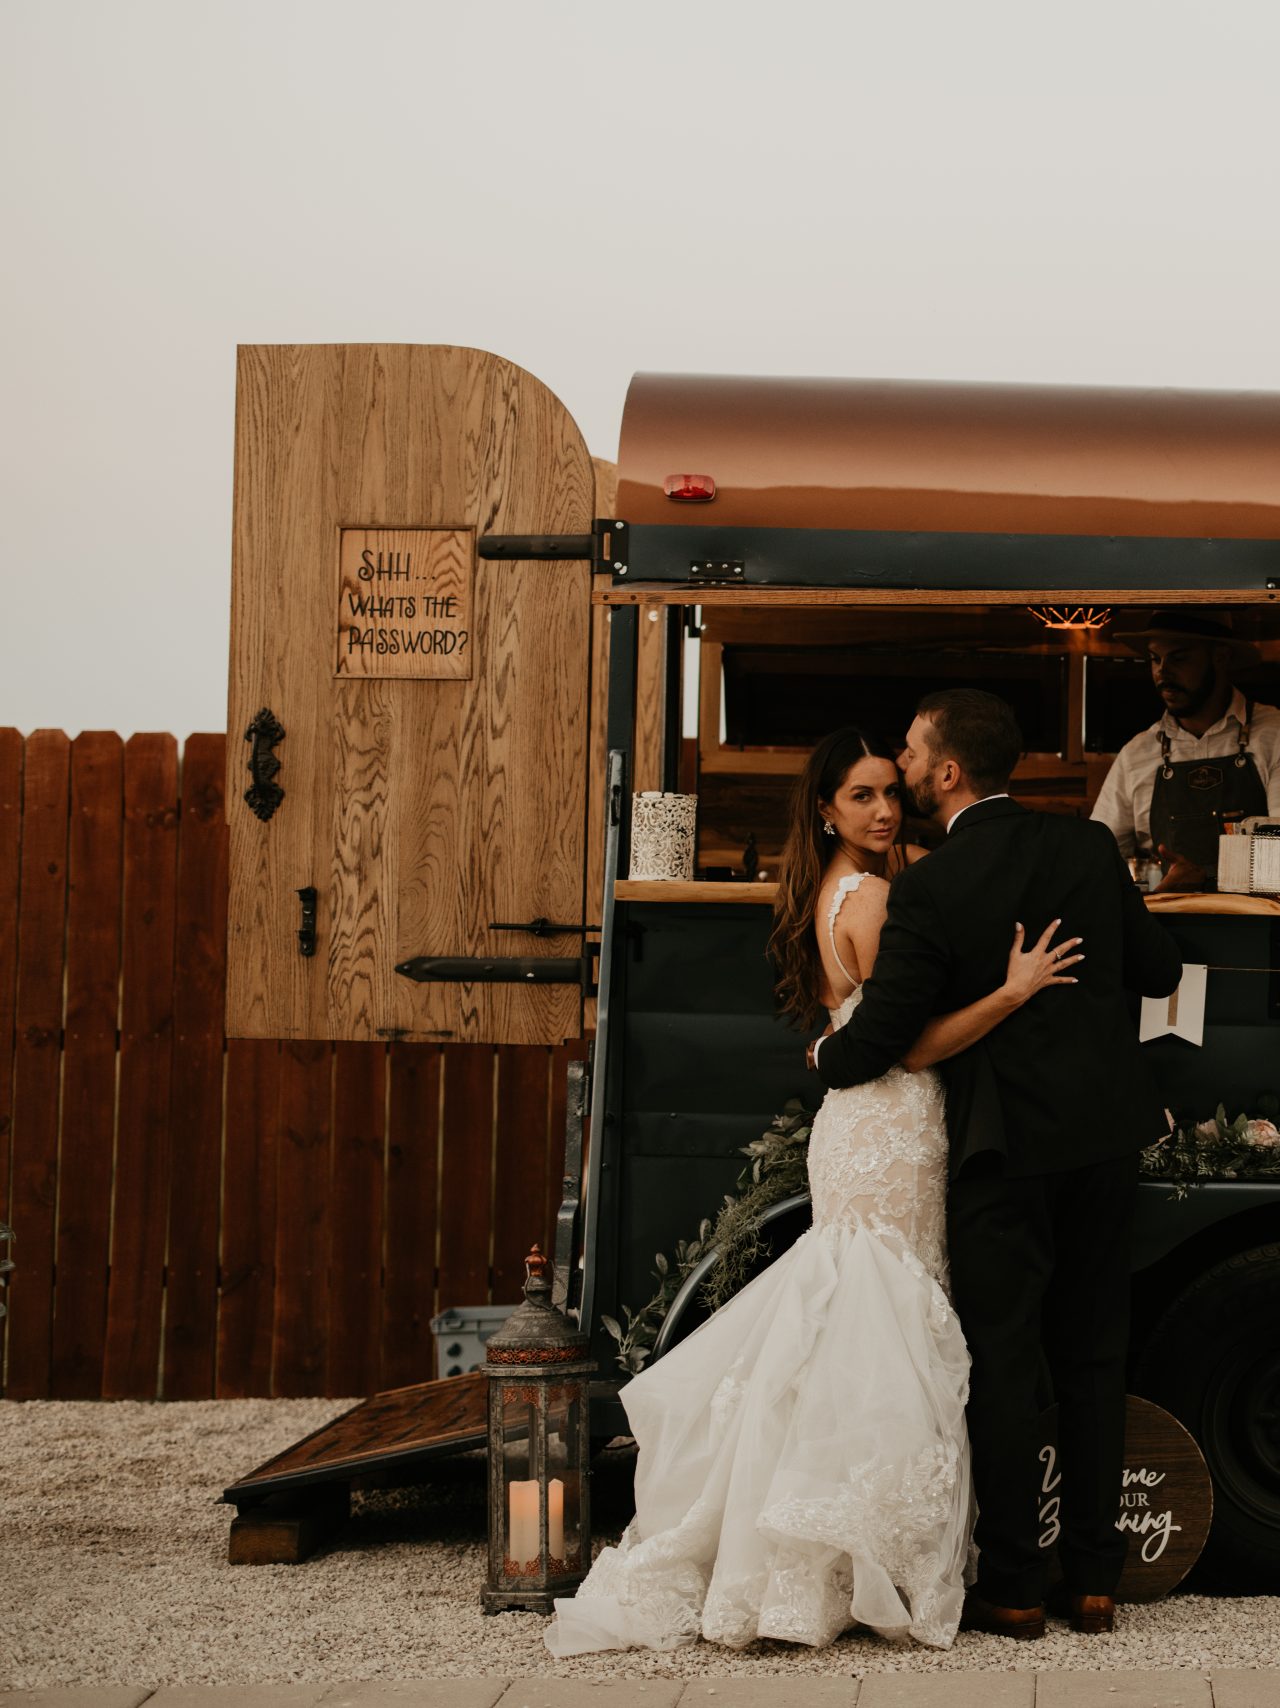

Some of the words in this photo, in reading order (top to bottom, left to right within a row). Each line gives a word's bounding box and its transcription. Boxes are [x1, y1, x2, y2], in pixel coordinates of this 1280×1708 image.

[349, 593, 416, 618] WHATS
[423, 596, 457, 618] THE
[348, 626, 469, 655] PASSWORD?
